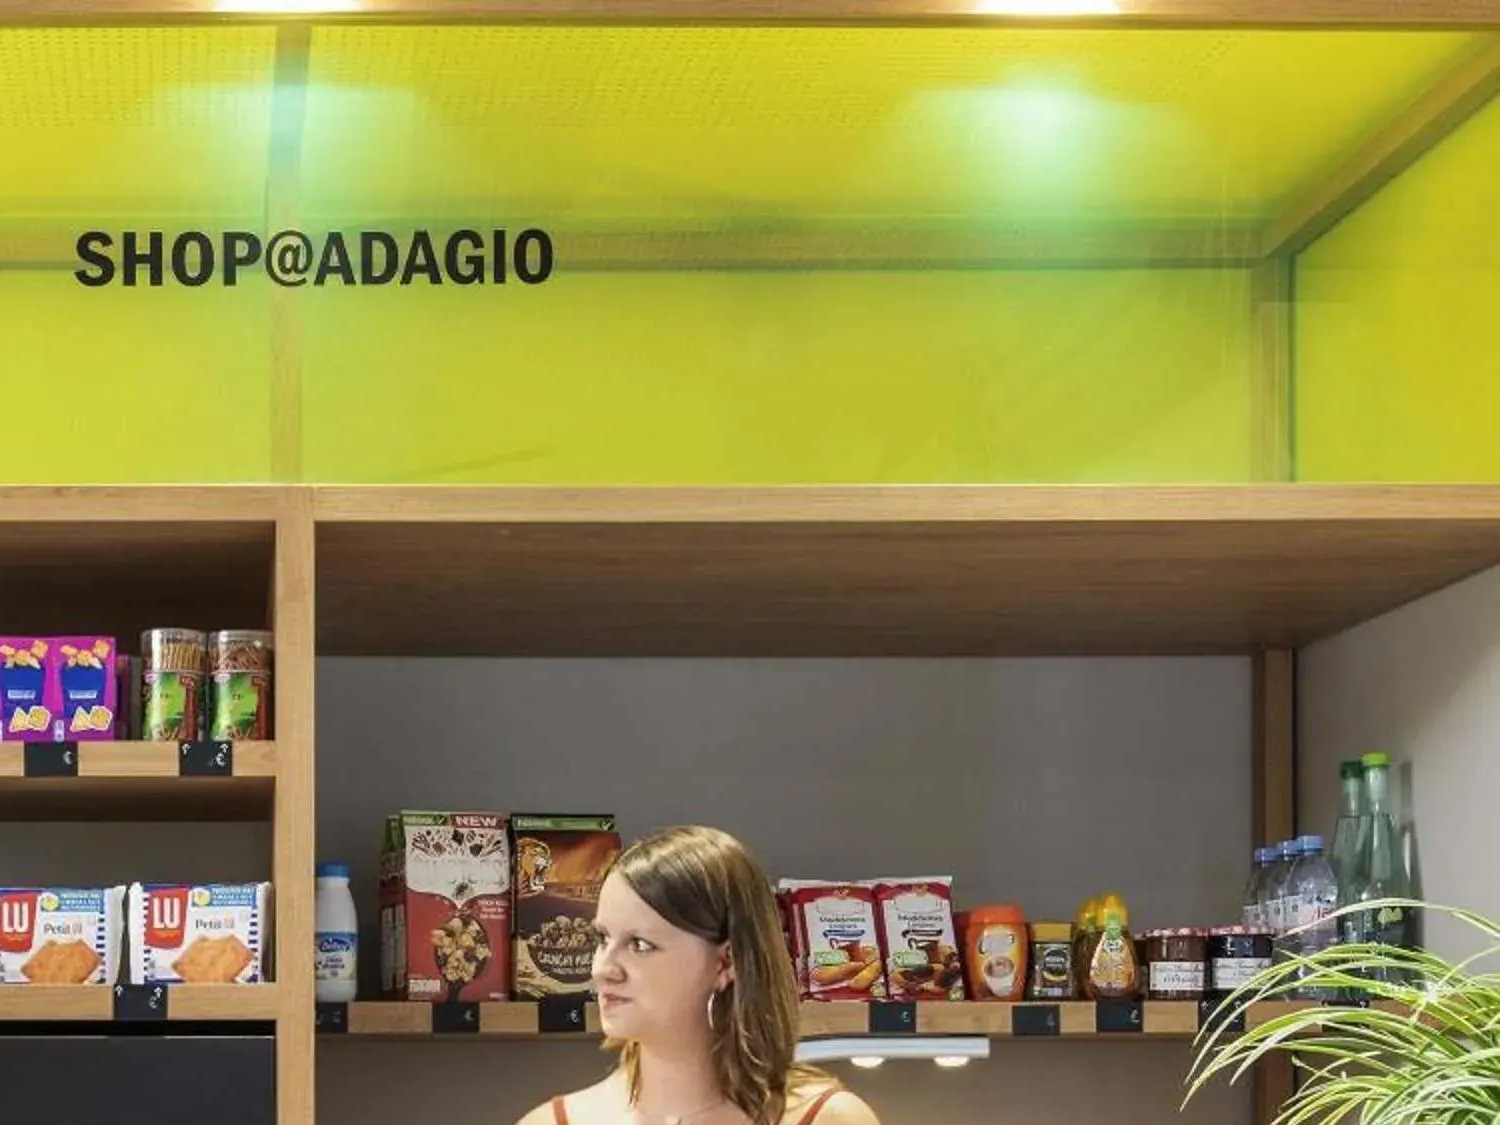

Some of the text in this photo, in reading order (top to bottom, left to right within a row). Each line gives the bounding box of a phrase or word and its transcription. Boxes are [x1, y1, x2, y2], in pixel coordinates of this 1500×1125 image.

[74, 229, 553, 287] SHOP@ADAGIO
[455, 815, 499, 828] NEW
[2, 901, 29, 933] LU
[153, 897, 180, 929] LU
